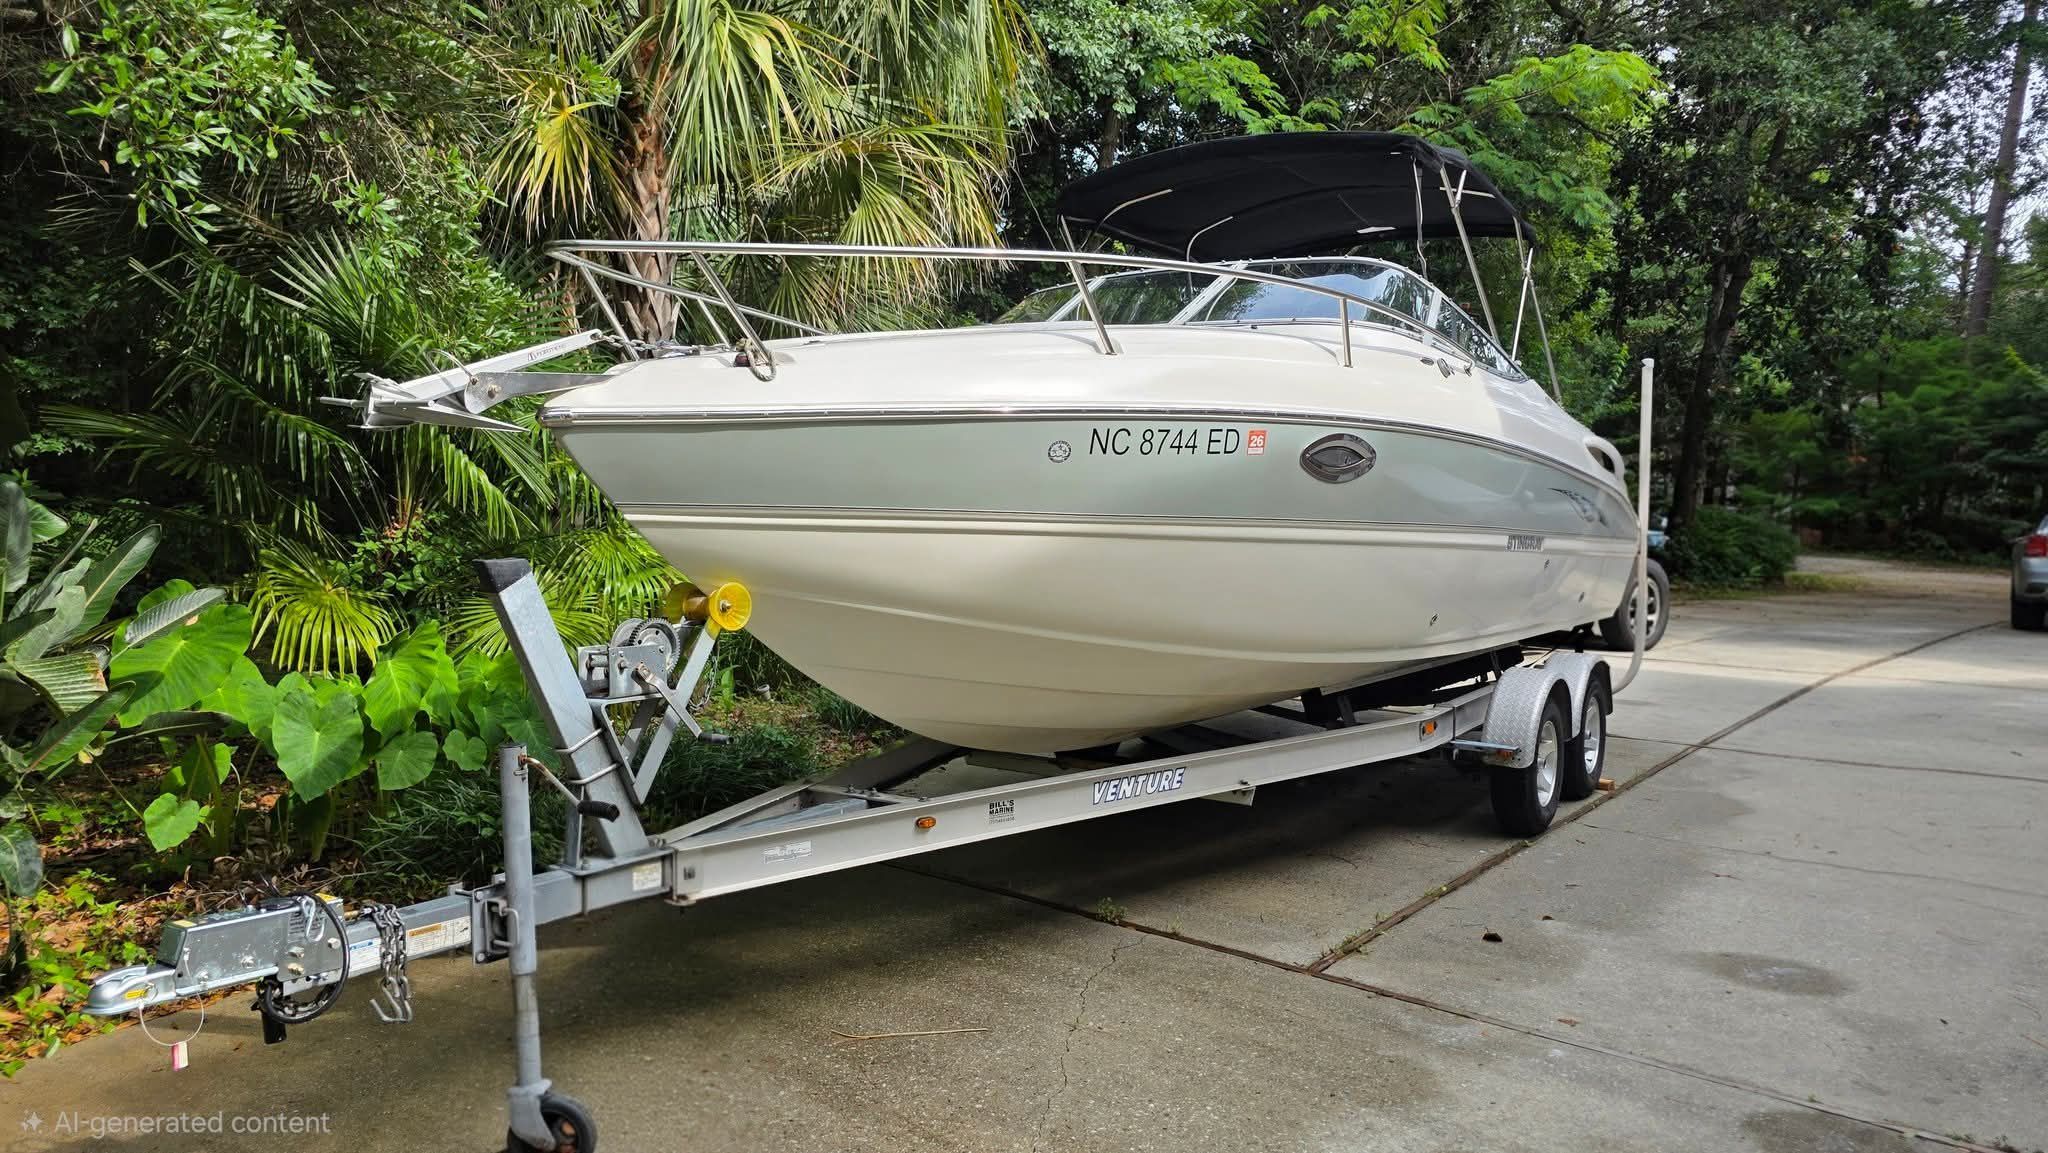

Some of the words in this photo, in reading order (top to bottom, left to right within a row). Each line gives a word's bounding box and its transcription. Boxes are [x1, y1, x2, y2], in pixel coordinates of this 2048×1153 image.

[1089, 428, 1131, 455] NC
[1140, 428, 1198, 455] 8744
[1207, 428, 1240, 454] ED
[1250, 435, 1264, 447] 26
[1093, 766, 1187, 805] VENTURE
[989, 799, 1015, 810] BILL'S
[989, 806, 1015, 815] MARINE
